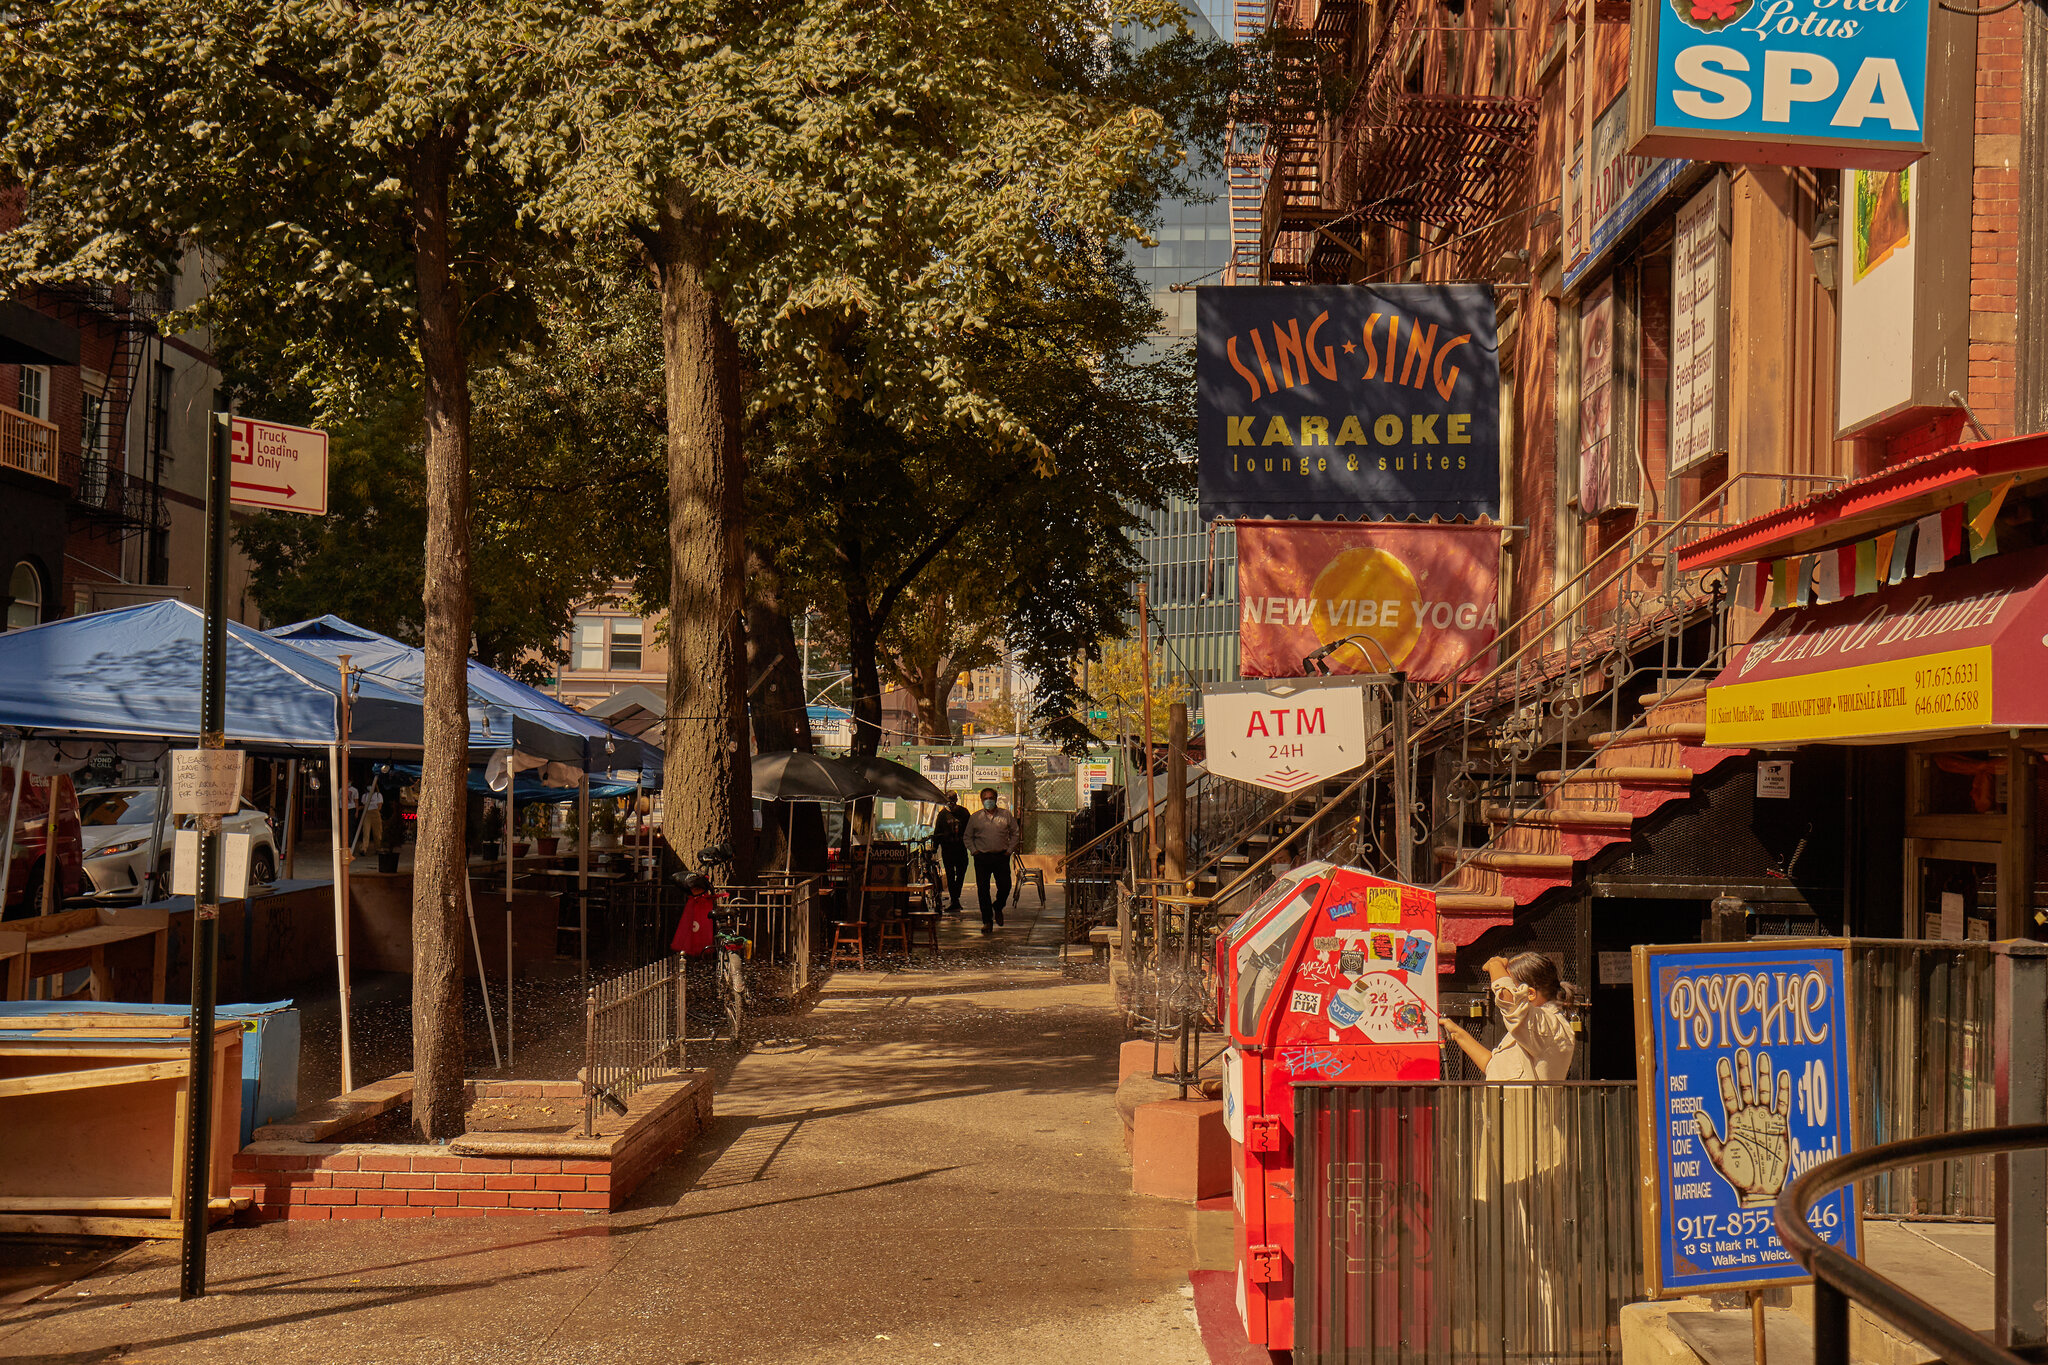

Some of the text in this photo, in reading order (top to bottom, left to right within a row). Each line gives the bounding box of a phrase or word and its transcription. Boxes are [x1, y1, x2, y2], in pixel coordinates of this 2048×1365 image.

[1741, 0, 1864, 41] Lotus
[1672, 44, 1920, 131] SPA
[1227, 309, 1472, 403] SING SING
[258, 428, 288, 444] Truck
[1227, 413, 1472, 446] KARAOKE
[257, 441, 299, 462] Loading
[257, 455, 281, 472] Only
[1233, 452, 1466, 476] lounge & suites
[1243, 596, 1497, 631] NEW VIBE YOGA
[1771, 619, 1849, 664] LAND
[1877, 586, 2015, 646] BUDDHA
[1915, 663, 1979, 689] 917.675.6331
[1771, 699, 1801, 719] HIMALAYAN
[1802, 699, 1817, 717] GIFT
[1817, 697, 1832, 715] SHOP
[1838, 690, 1875, 713] WHOLESALE
[1883, 686, 1907, 708] RETAIL
[1914, 690, 1980, 716] 646.602.6588
[1246, 707, 1326, 738] ATM
[1718, 706, 1732, 723] Saint
[1268, 743, 1304, 759] 24H
[869, 846, 905, 857] SAPPORO
[1369, 992, 1388, 1004] 24
[1670, 970, 1828, 1050] PSYCHIC
[1669, 1075, 1688, 1092] PAST
[1797, 1058, 1828, 1127] $10
[1671, 1096, 1704, 1114] PRESENT
[1671, 1119, 1701, 1137] FUTURE
[1672, 1138, 1693, 1156] LOVE
[1673, 1160, 1700, 1178] MONEY
[1674, 1182, 1712, 1200] MARRIAGE
[1677, 1203, 1839, 1241] 917-855-46
[1684, 1244, 1696, 1255] 13
[1699, 1242, 1712, 1254] St
[1715, 1240, 1742, 1252] Mark
[1745, 1238, 1759, 1250] Pl.
[1712, 1250, 1793, 1267] Walk-Ins Welco
